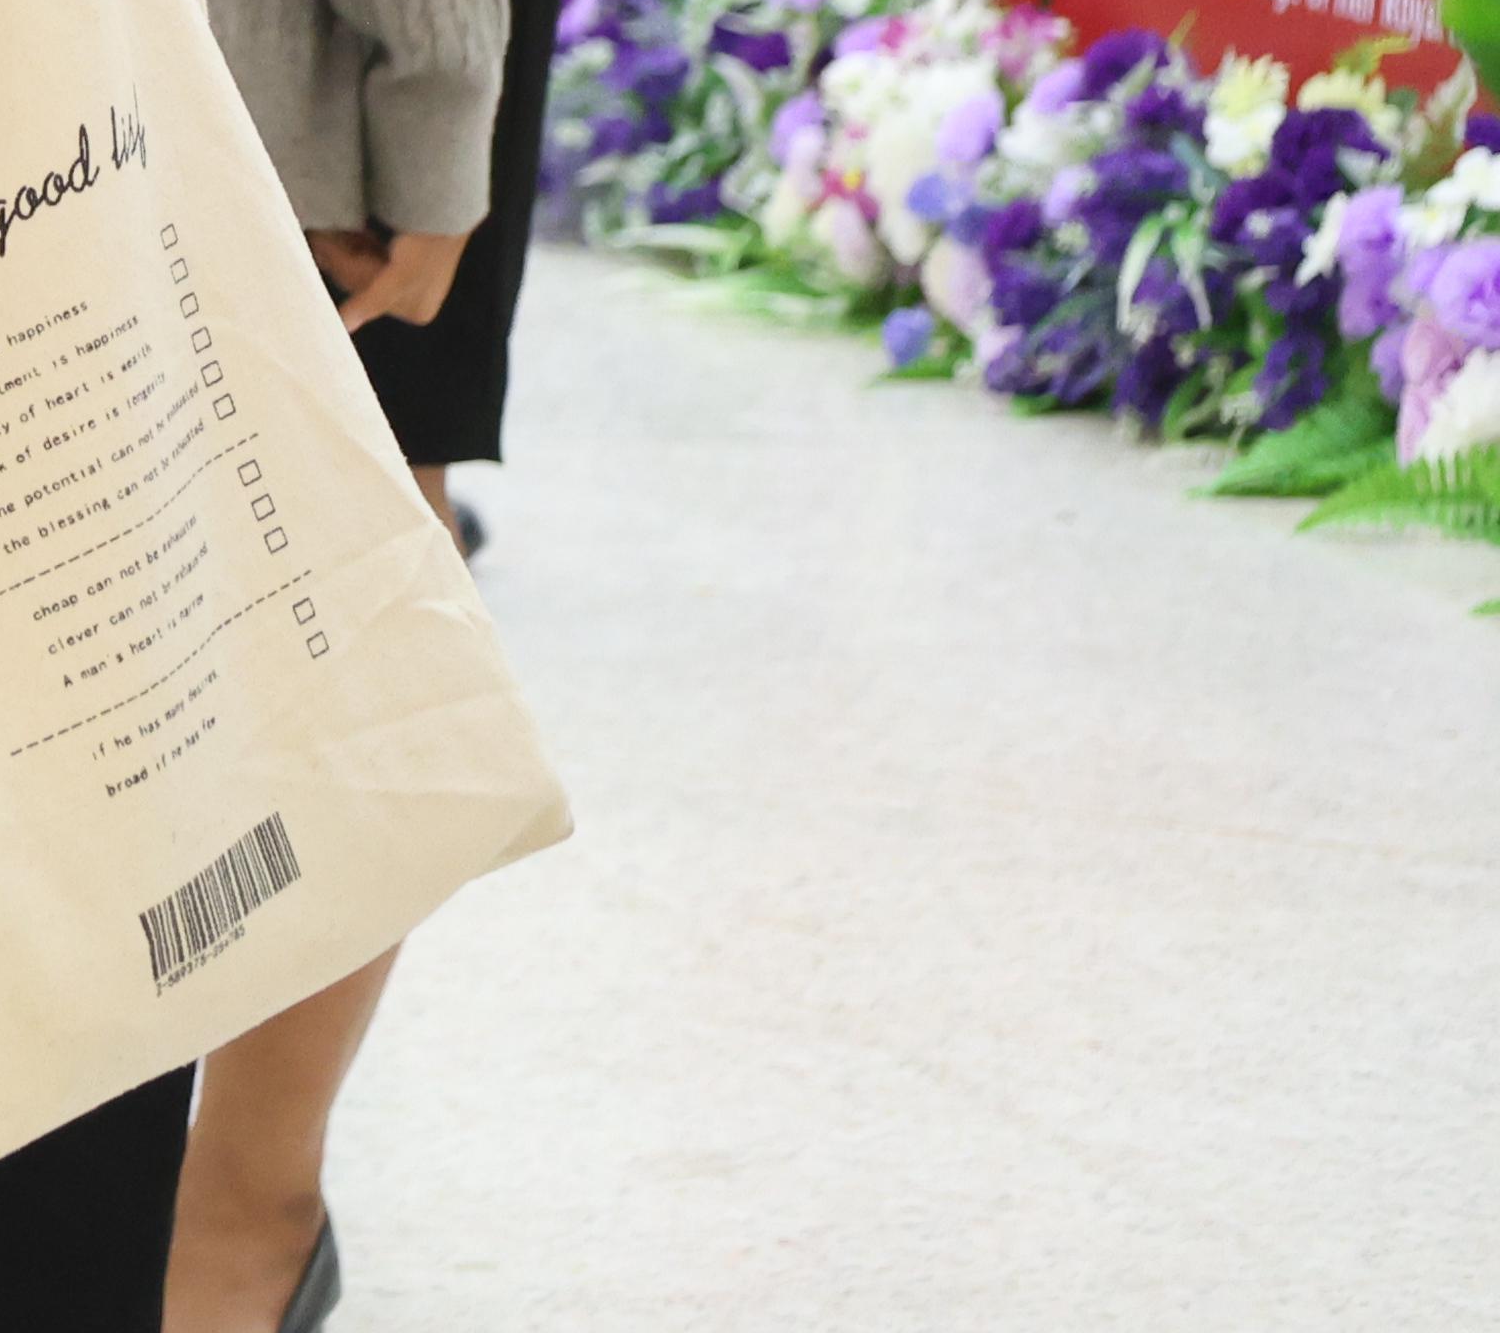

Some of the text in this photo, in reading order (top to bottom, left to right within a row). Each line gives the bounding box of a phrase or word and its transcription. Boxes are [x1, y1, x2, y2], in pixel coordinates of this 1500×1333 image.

[6, 301, 88, 347] happiness
[52, 354, 69, 370] is
[74, 315, 139, 357] happiness
[19, 404, 36, 424] of
[45, 383, 90, 410] heart
[100, 371, 115, 384] is
[16, 445, 32, 463] of
[43, 419, 97, 451] desire
[106, 407, 120, 421] is
[24, 458, 103, 507] potential
[111, 445, 134, 463] can
[138, 429, 155, 447] not
[3, 536, 31, 555] the
[37, 498, 112, 539] blessing
[117, 483, 139, 501] can
[143, 467, 159, 484] not
[33, 593, 79, 621] cheap
[86, 576, 113, 597] can
[119, 560, 141, 580] not
[146, 550, 159, 565] be
[48, 622, 100, 655] clever
[109, 605, 135, 626] can
[139, 590, 159, 610] not
[63, 673, 74, 689] A
[129, 627, 164, 655] heart
[92, 742, 106, 761] if
[114, 734, 132, 750] he
[138, 718, 162, 737] has
[105, 766, 149, 798] broad
